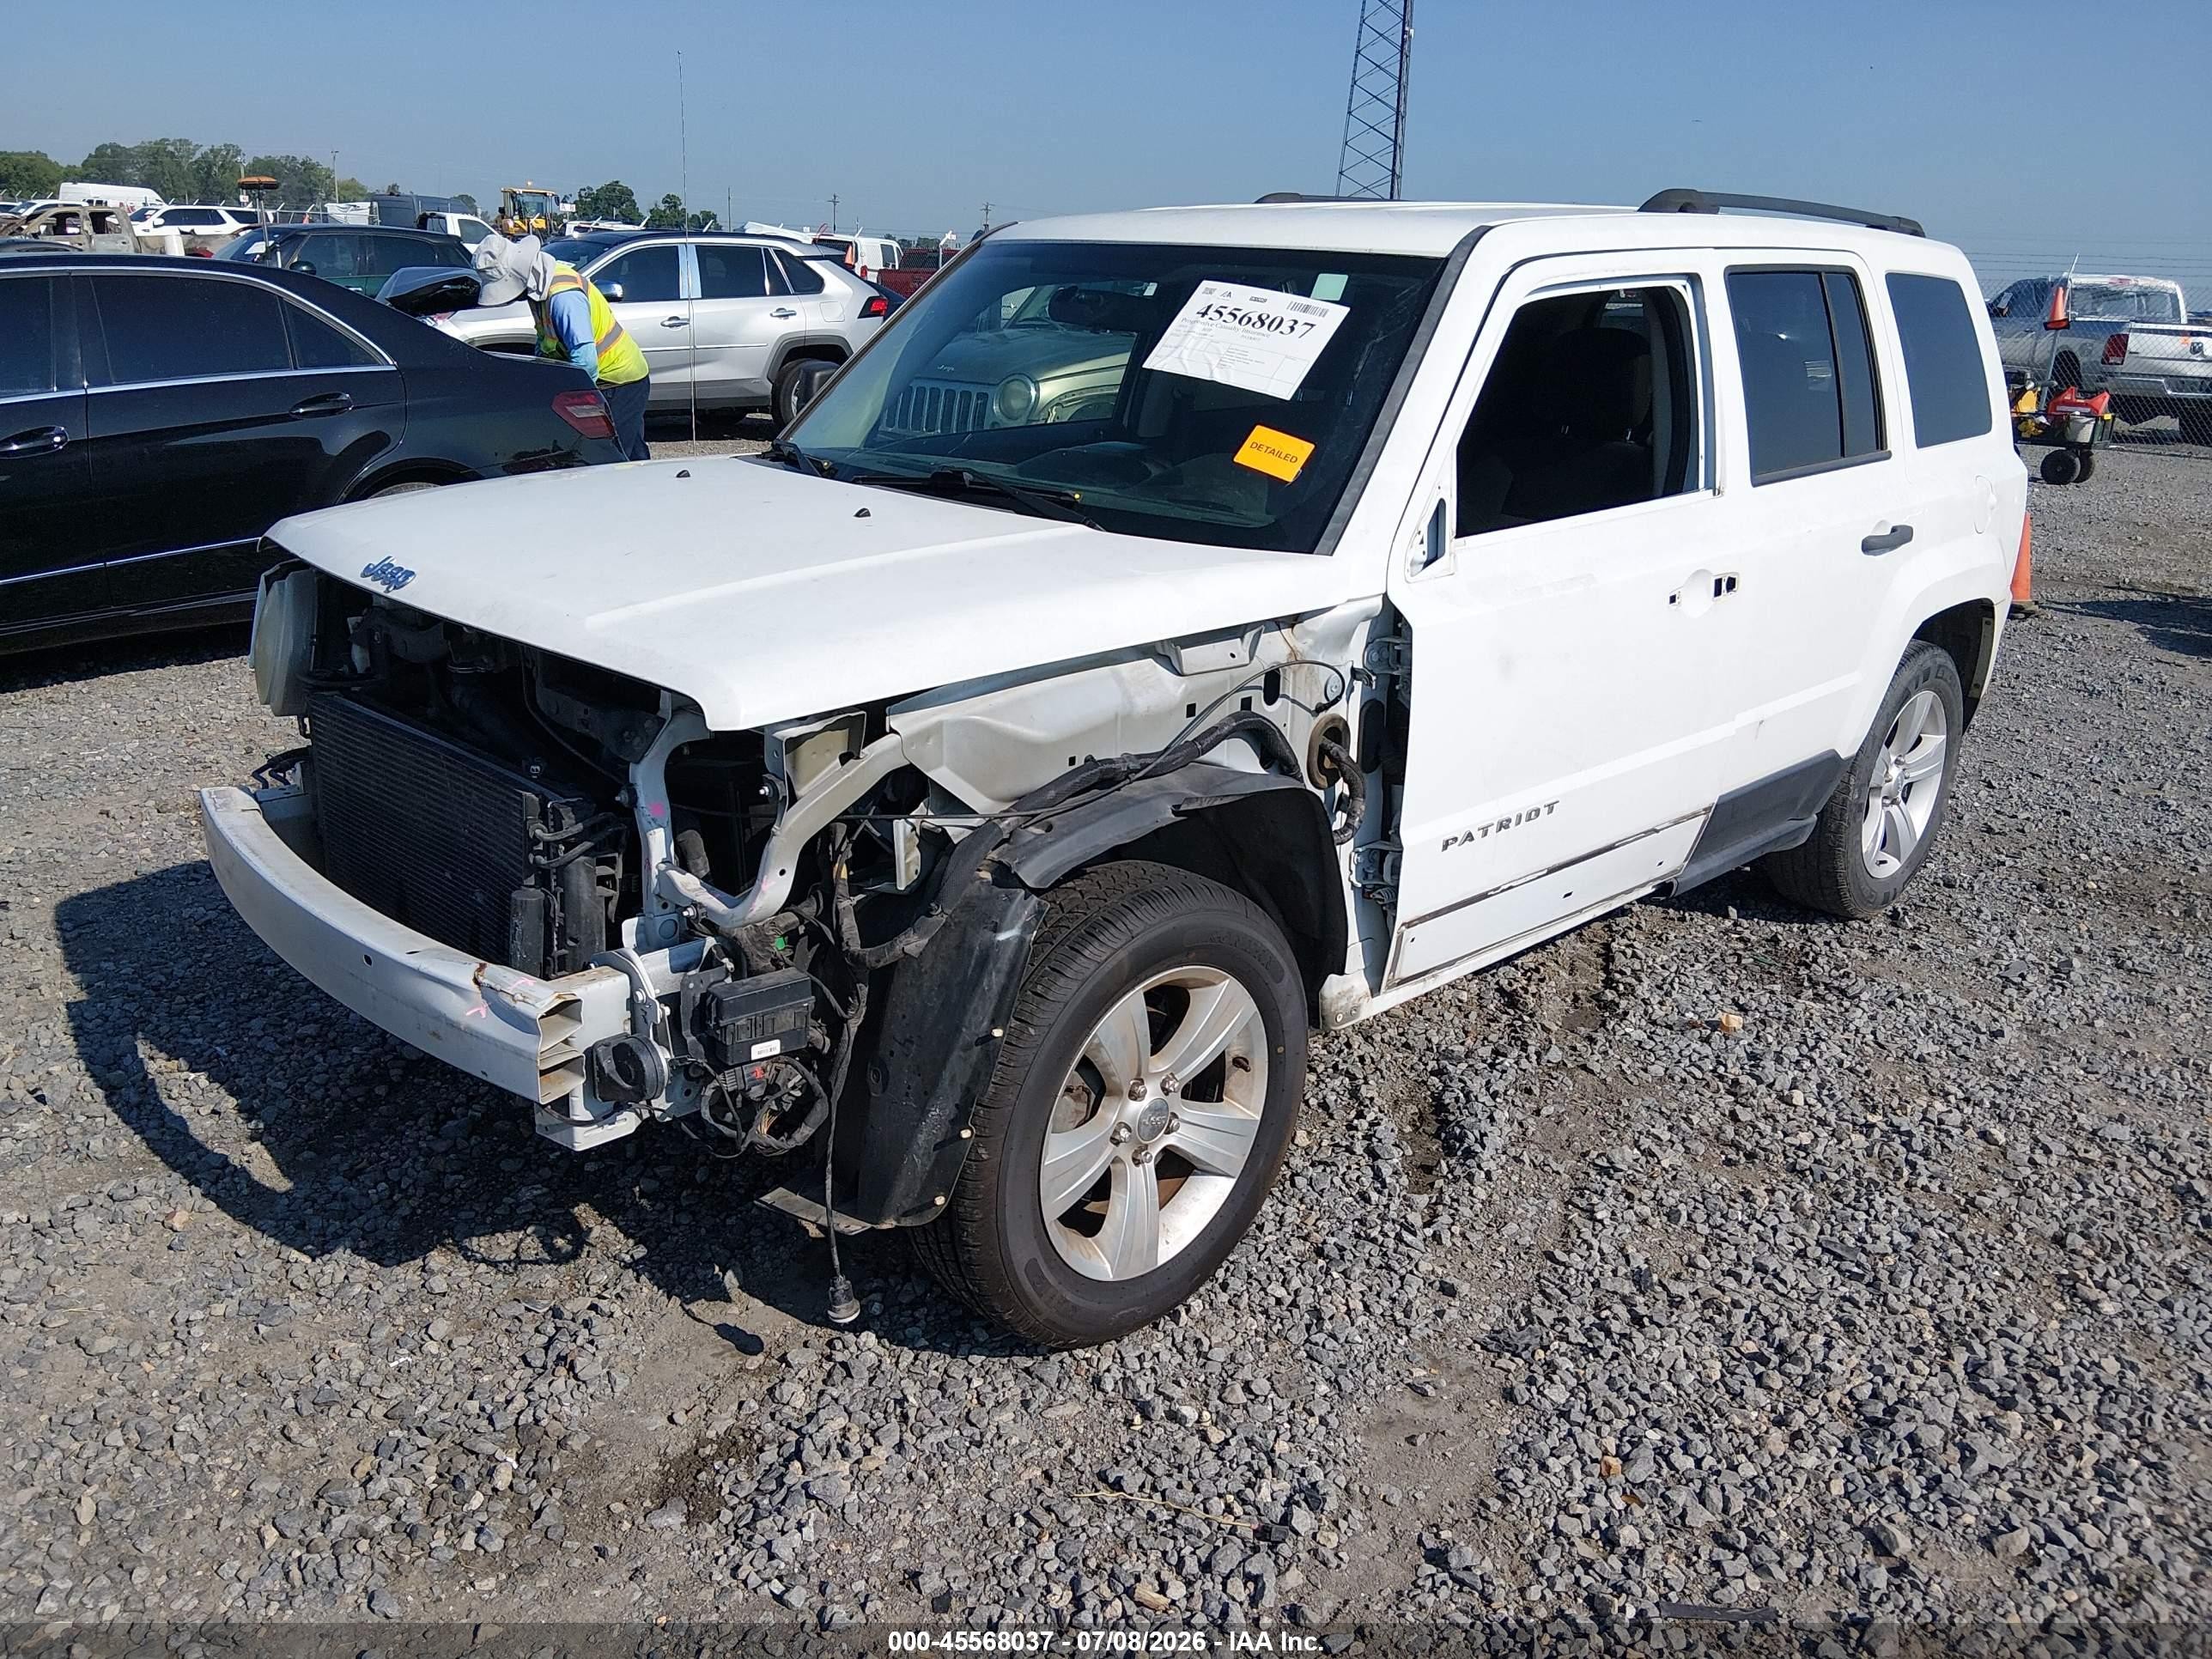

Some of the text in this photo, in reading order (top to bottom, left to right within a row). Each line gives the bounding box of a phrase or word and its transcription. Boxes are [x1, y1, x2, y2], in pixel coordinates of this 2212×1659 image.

[1195, 303, 1316, 339] 45568037
[1249, 441, 1298, 464] DETAILED
[360, 556, 416, 593] Jeep
[1441, 799, 1560, 852] PATRIOT
